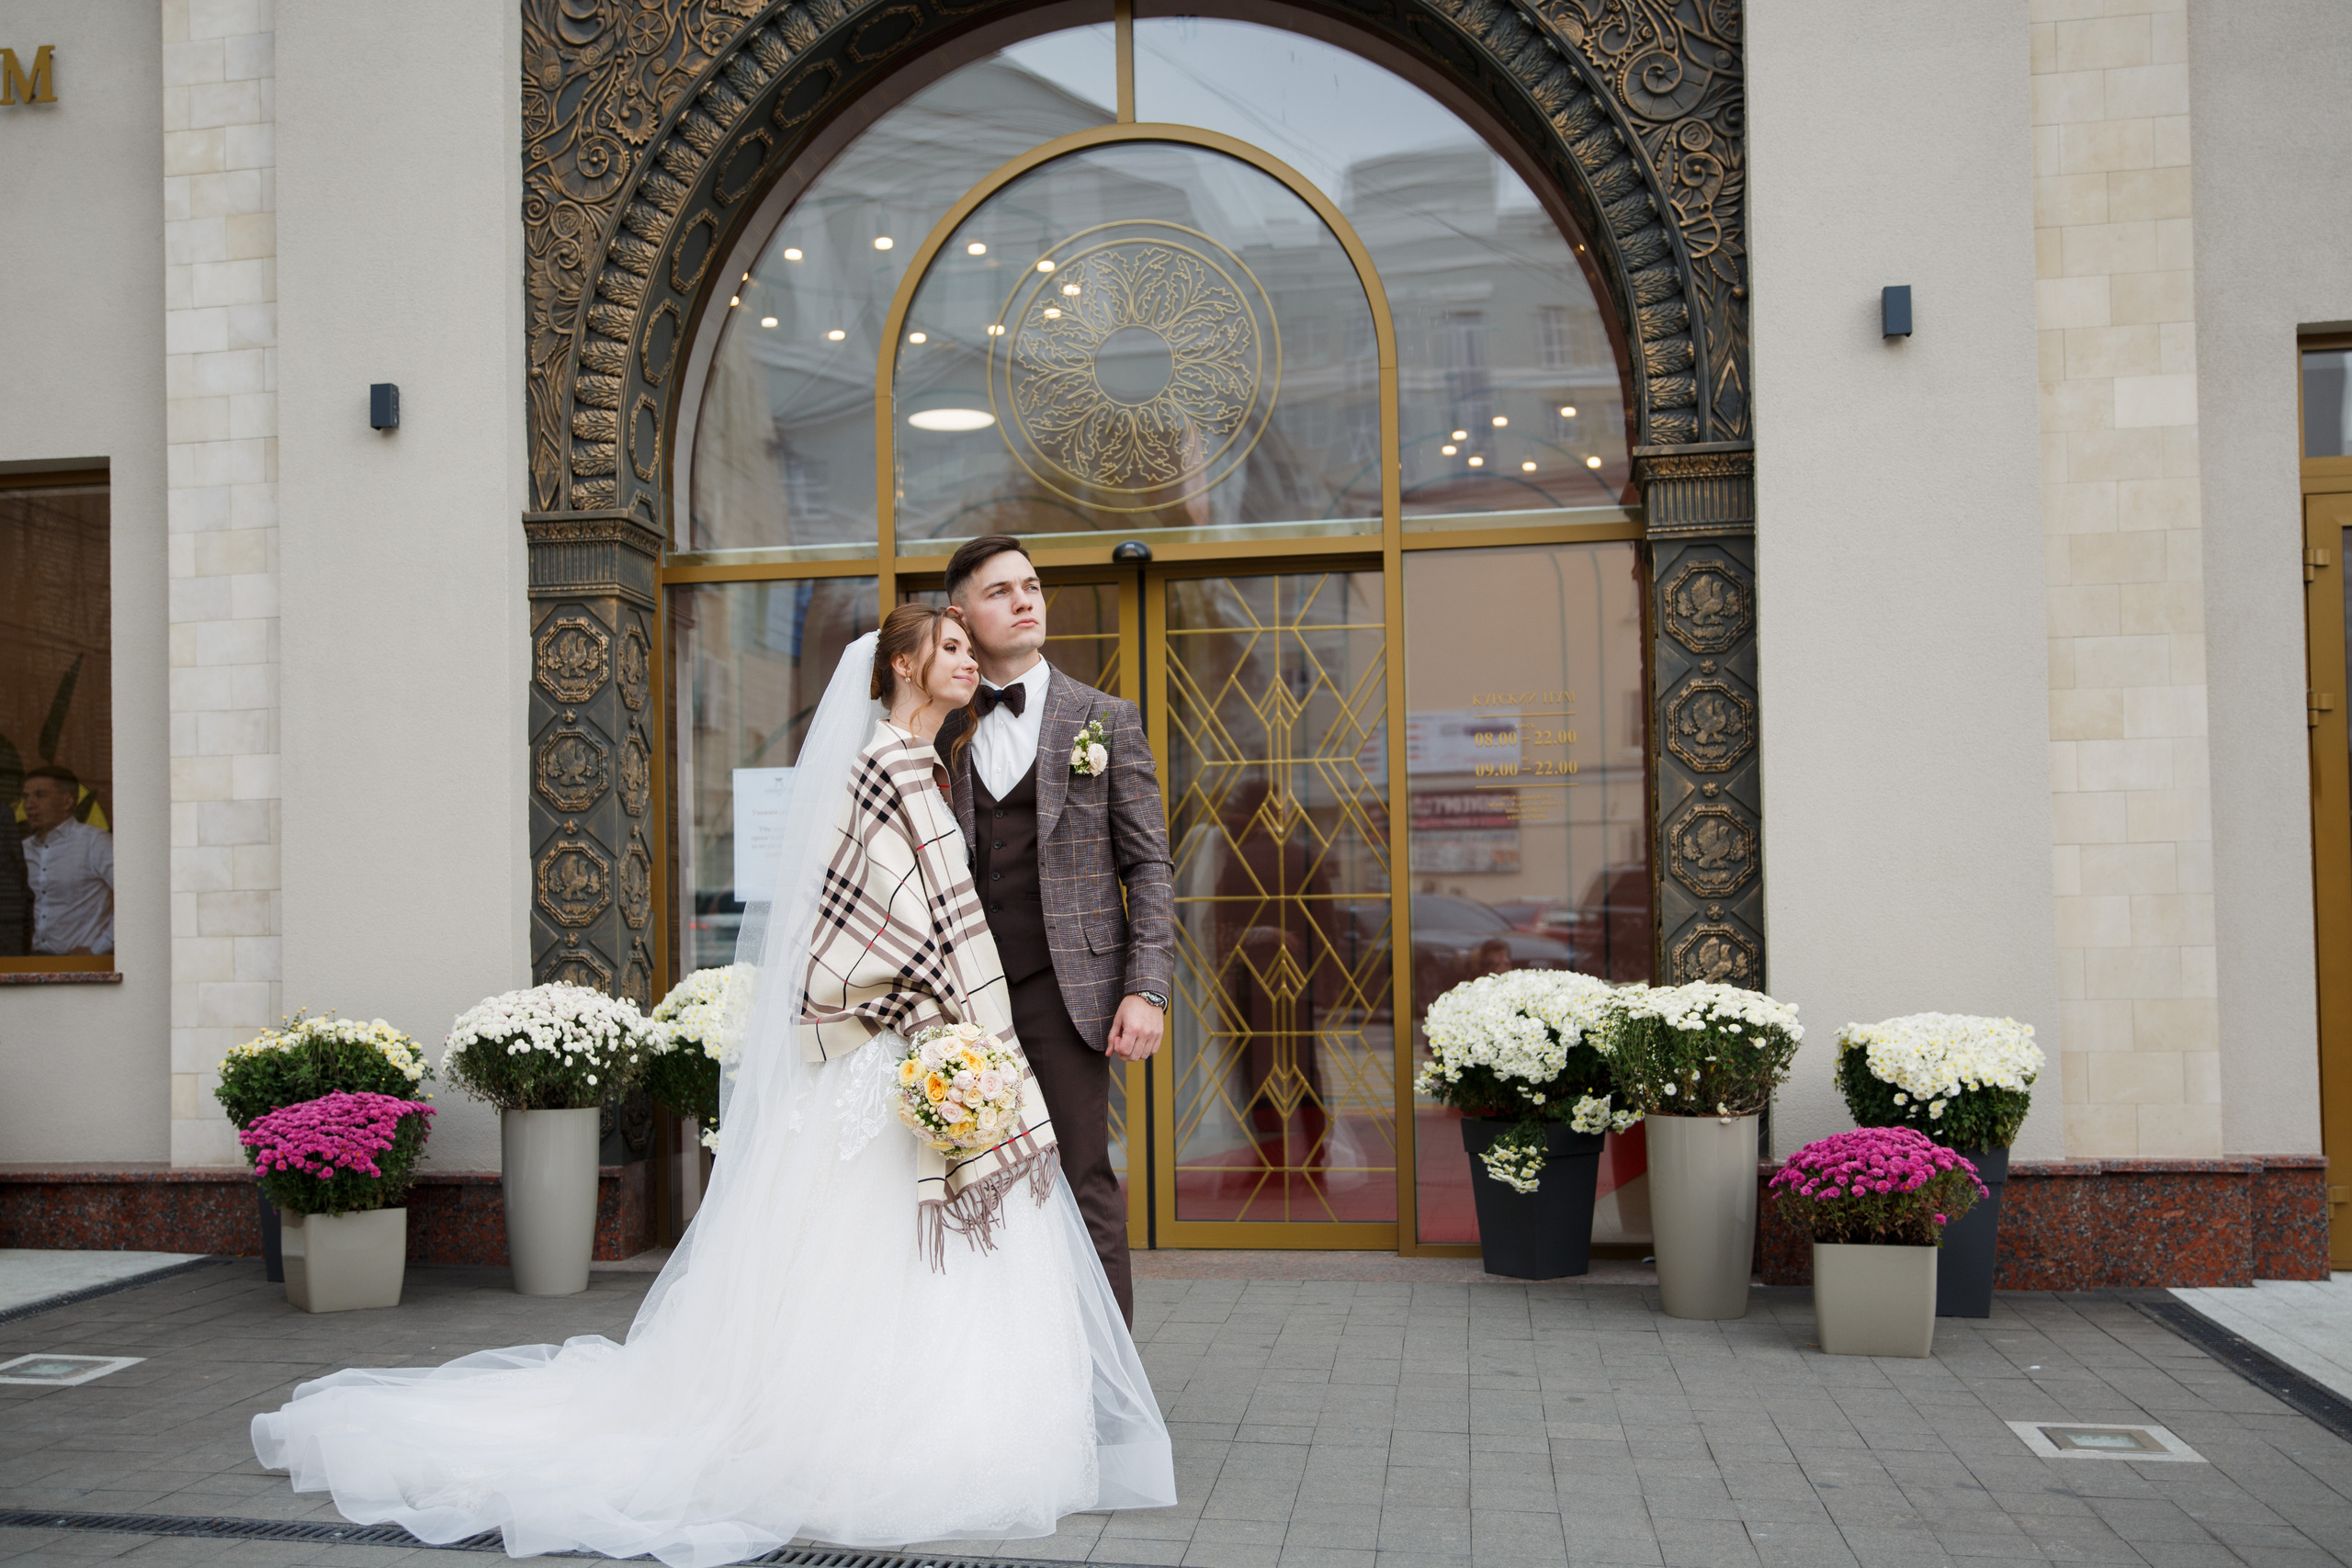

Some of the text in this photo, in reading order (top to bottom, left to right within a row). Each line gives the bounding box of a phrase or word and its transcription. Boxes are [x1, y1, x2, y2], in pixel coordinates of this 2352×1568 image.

[1475, 731, 1517, 747] 08.00
[1533, 729, 1577, 746] 22.00
[1476, 761, 1518, 777] 09.00
[1534, 760, 1577, 775] 22.00
